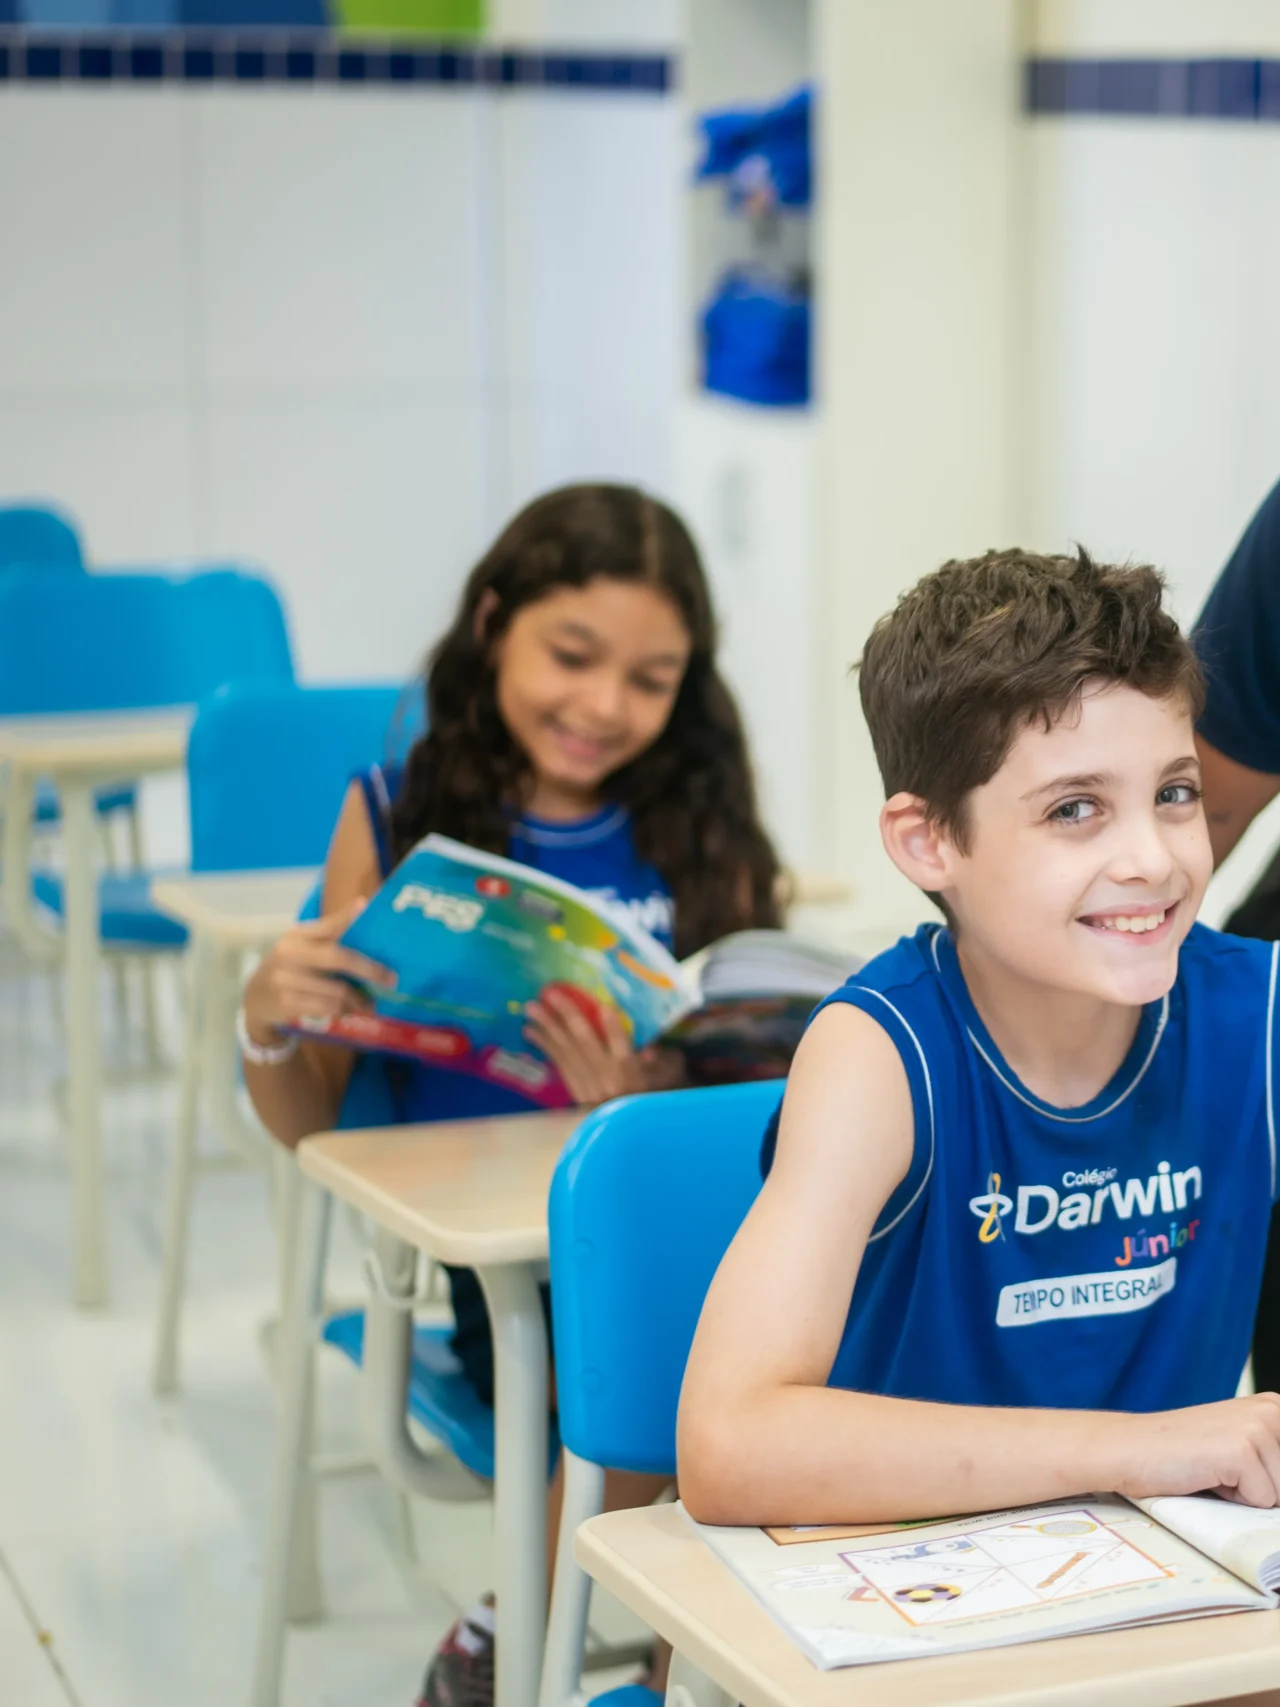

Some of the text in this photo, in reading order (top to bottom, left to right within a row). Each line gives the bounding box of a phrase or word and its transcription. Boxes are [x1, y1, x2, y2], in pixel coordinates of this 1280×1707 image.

[1062, 1166, 1118, 1188] Colégio
[1014, 1160, 1202, 1234] Darwin
[1115, 1219, 1200, 1266] Júnior
[1071, 1273, 1162, 1305] INTEGRAL
